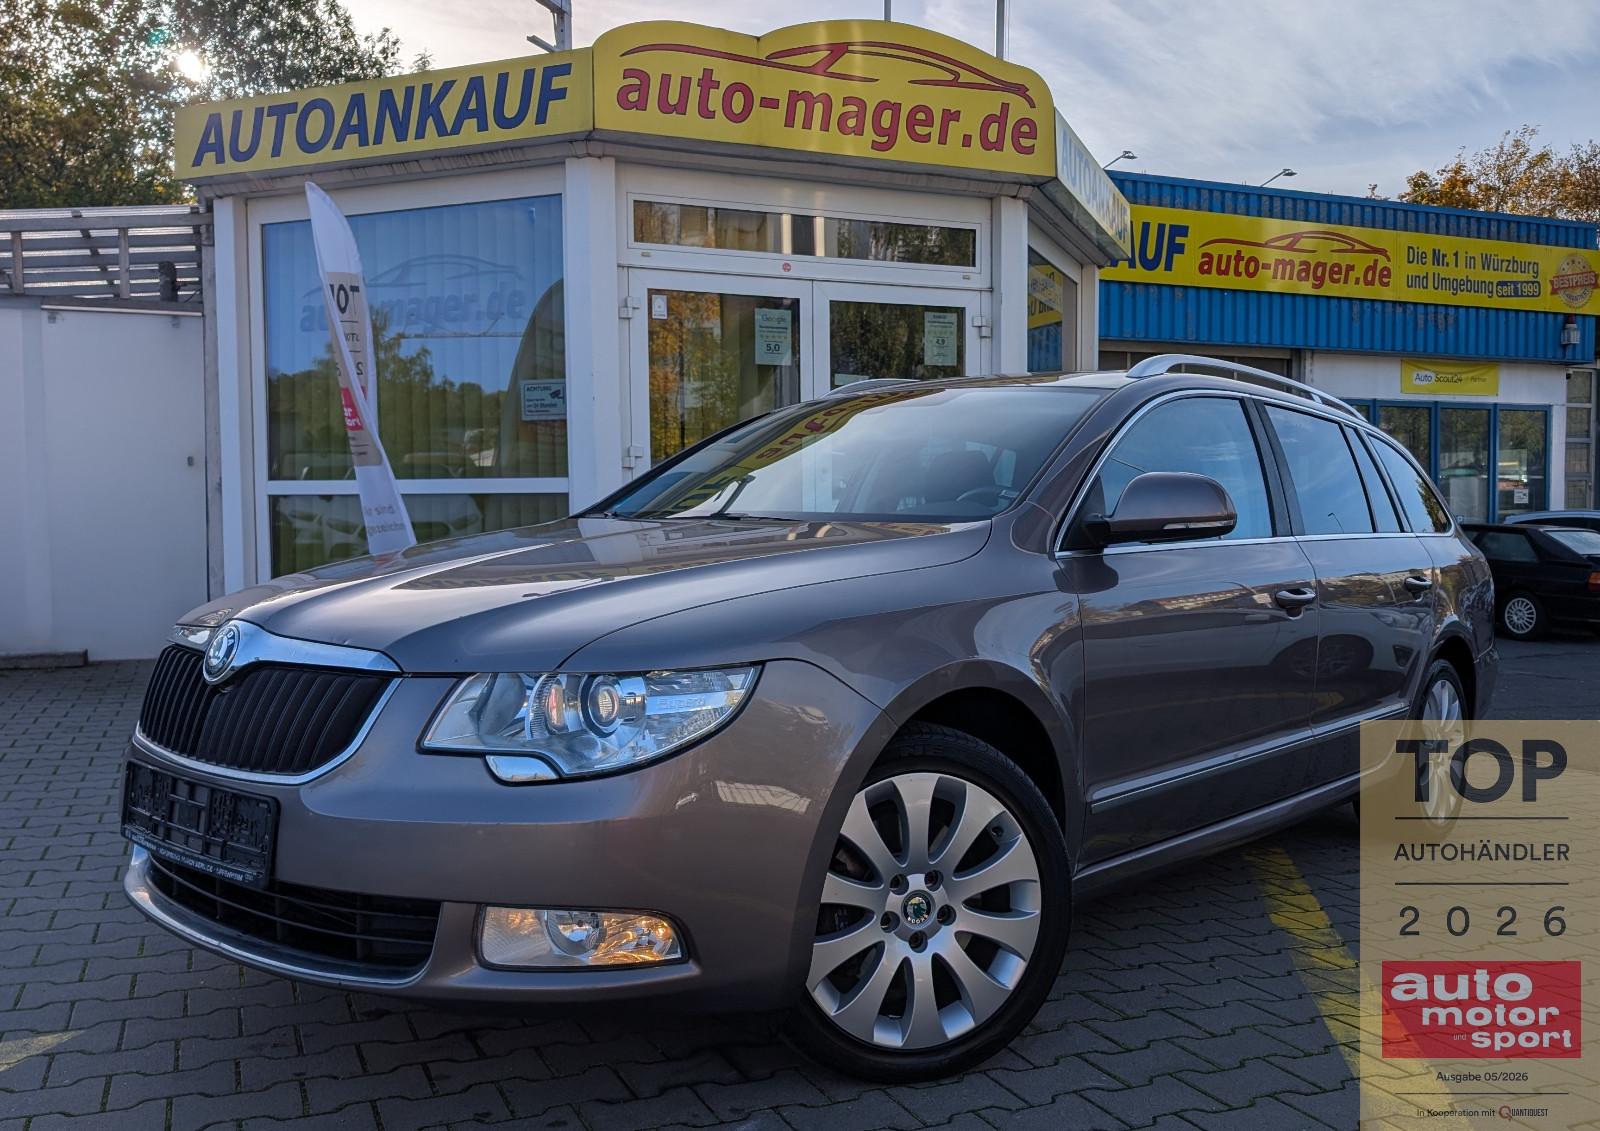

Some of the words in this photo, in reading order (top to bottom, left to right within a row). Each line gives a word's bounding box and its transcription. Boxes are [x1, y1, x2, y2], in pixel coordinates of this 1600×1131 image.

[191, 62, 573, 168] AUTOANKAUF
[616, 67, 1038, 156] auto-mager.de
[1198, 249, 1392, 290] auto-mager.de
[1406, 245, 1428, 266] Die
[1432, 247, 1450, 267] Nr.
[1452, 250, 1459, 268] 1
[1464, 251, 1476, 270] in
[1480, 252, 1540, 279] Würzburg
[1553, 271, 1596, 289] BESTPREIS
[1406, 271, 1429, 290] und
[1432, 271, 1494, 298] Umgebung
[1497, 283, 1515, 296] seit
[1518, 282, 1540, 296] 1999
